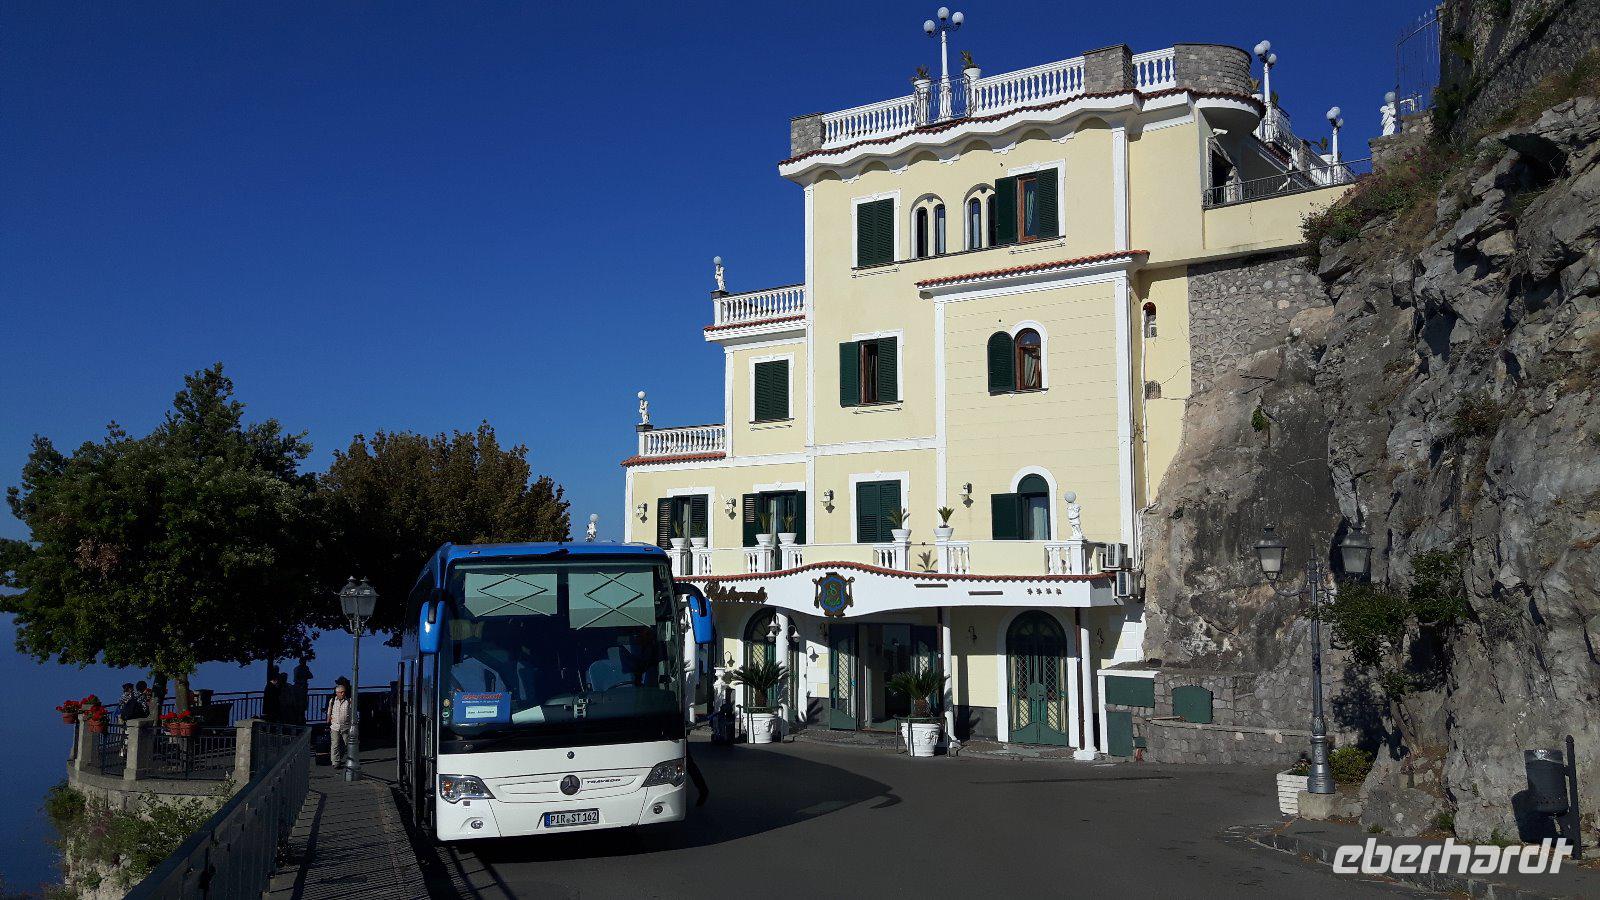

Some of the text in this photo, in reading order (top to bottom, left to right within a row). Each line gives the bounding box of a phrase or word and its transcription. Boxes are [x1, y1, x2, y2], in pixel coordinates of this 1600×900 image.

[551, 812, 597, 824] PIR ST 162
